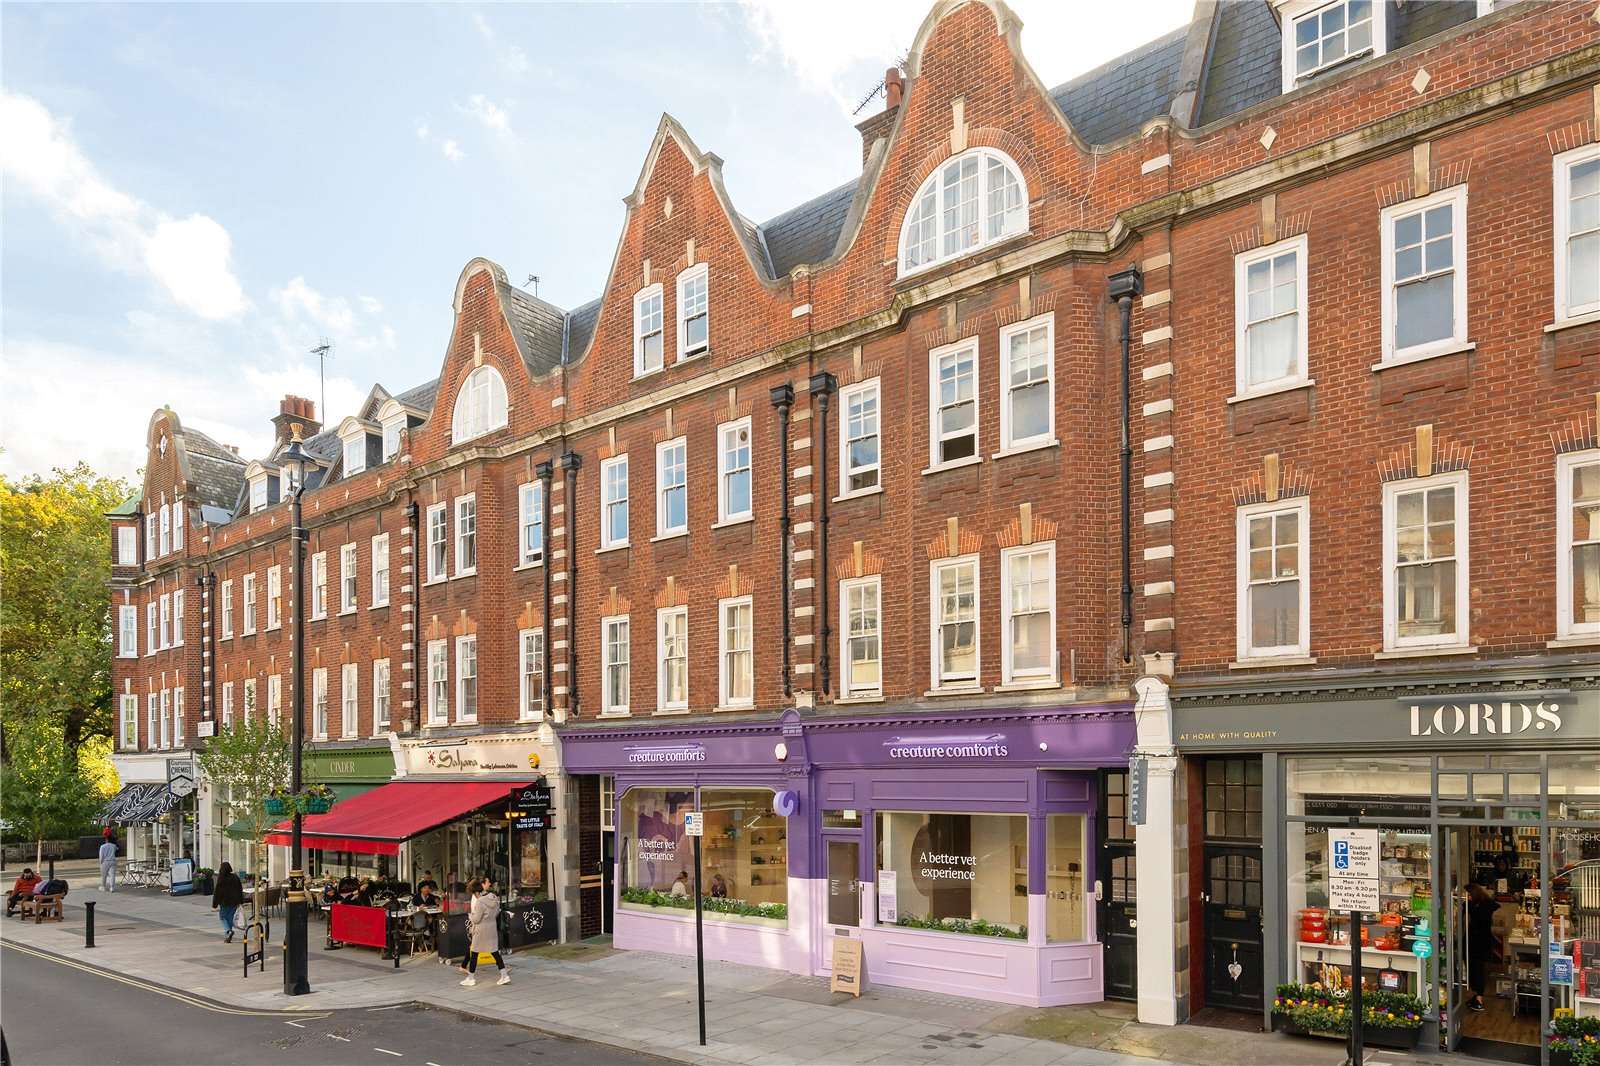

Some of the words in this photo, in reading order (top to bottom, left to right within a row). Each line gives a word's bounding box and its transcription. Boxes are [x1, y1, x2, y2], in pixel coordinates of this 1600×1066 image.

[1410, 701, 1562, 736] LORDS
[629, 751, 665, 762] creature
[665, 749, 705, 761] comforts
[889, 745, 945, 758] creature
[945, 743, 1008, 757] comforts
[330, 760, 356, 773] CINDER
[638, 838, 644, 848] A
[644, 838, 664, 849] better
[665, 841, 675, 849] vet
[1338, 842, 1347, 853] P
[639, 851, 674, 861] experience
[919, 851, 928, 863] A
[928, 851, 960, 865] better
[960, 855, 977, 866] vet
[921, 867, 976, 880] experience
